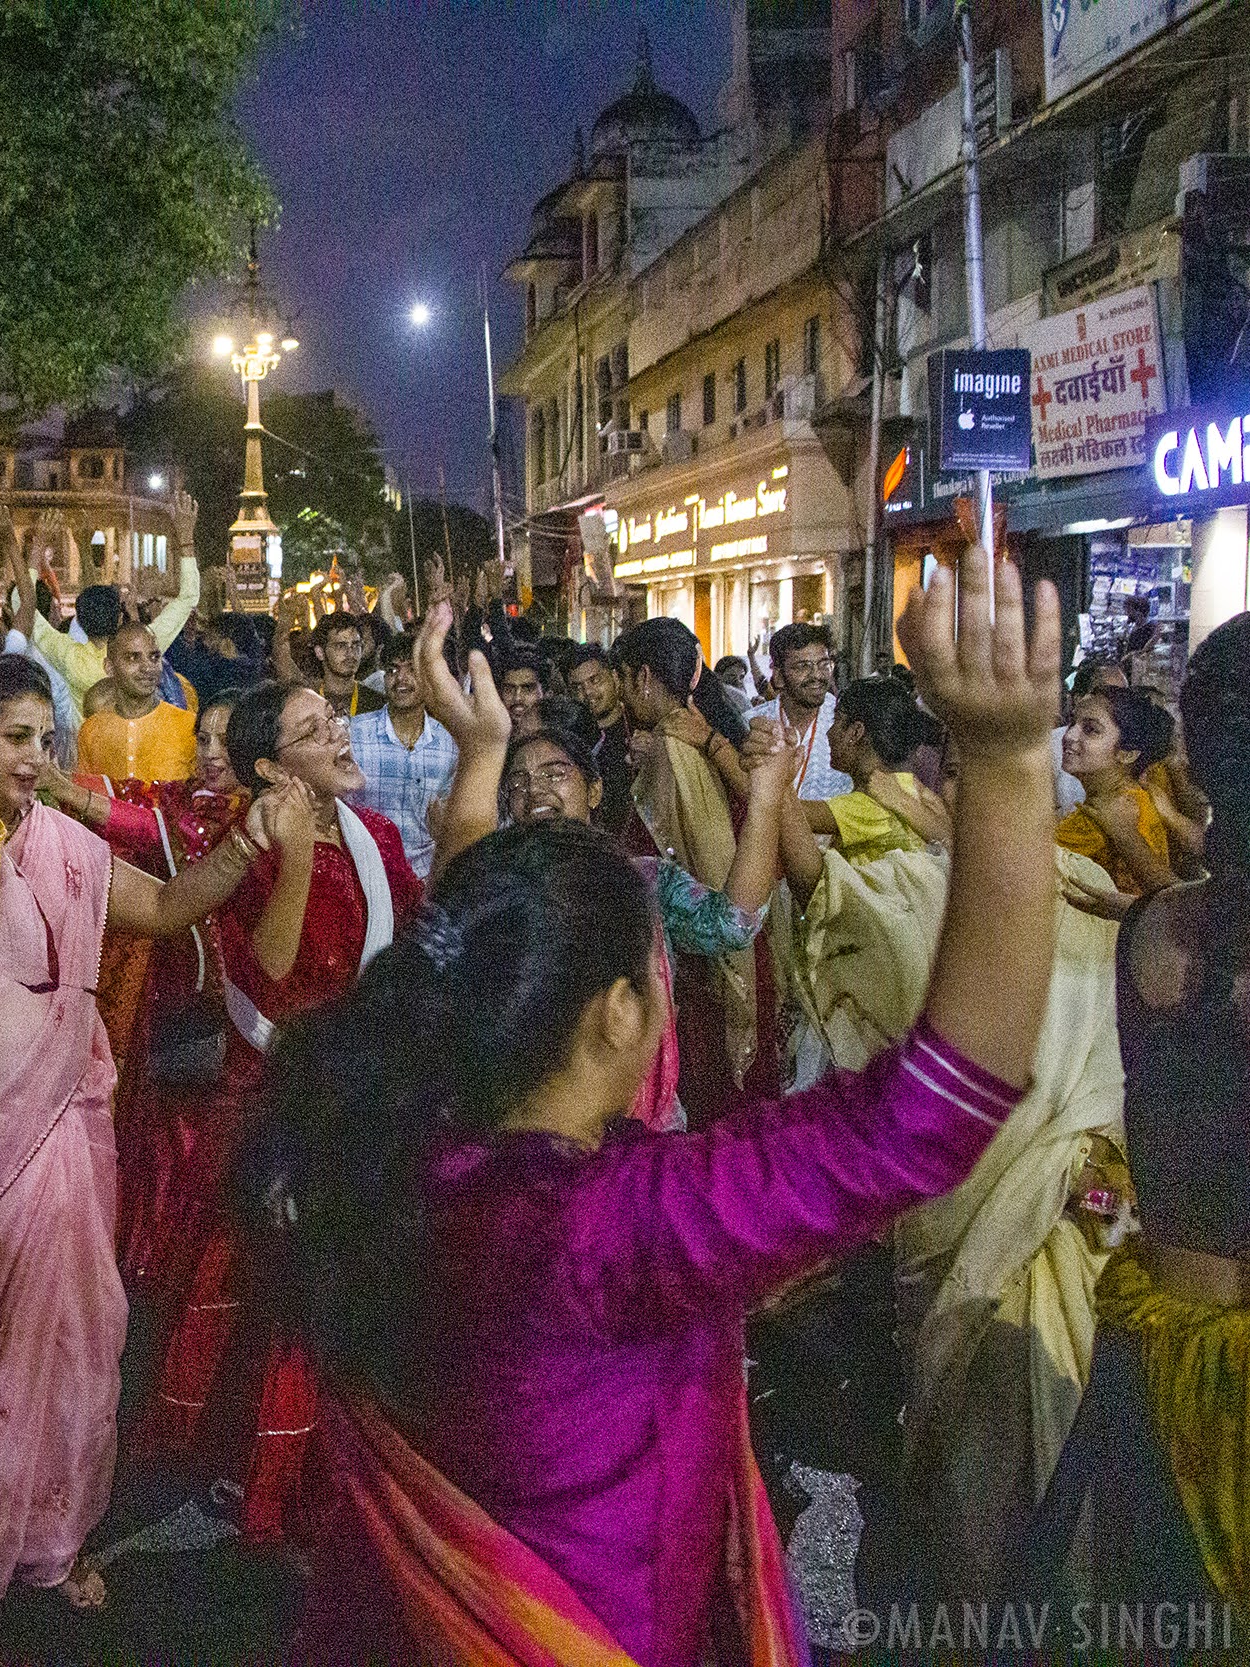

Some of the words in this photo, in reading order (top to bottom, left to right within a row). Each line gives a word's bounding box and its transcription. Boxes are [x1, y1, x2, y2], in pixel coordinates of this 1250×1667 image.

[1061, 338, 1108, 366] MEDICAL
[1112, 324, 1152, 351] STORE
[954, 368, 1021, 400] imagine
[1038, 416, 1082, 443] Medical
